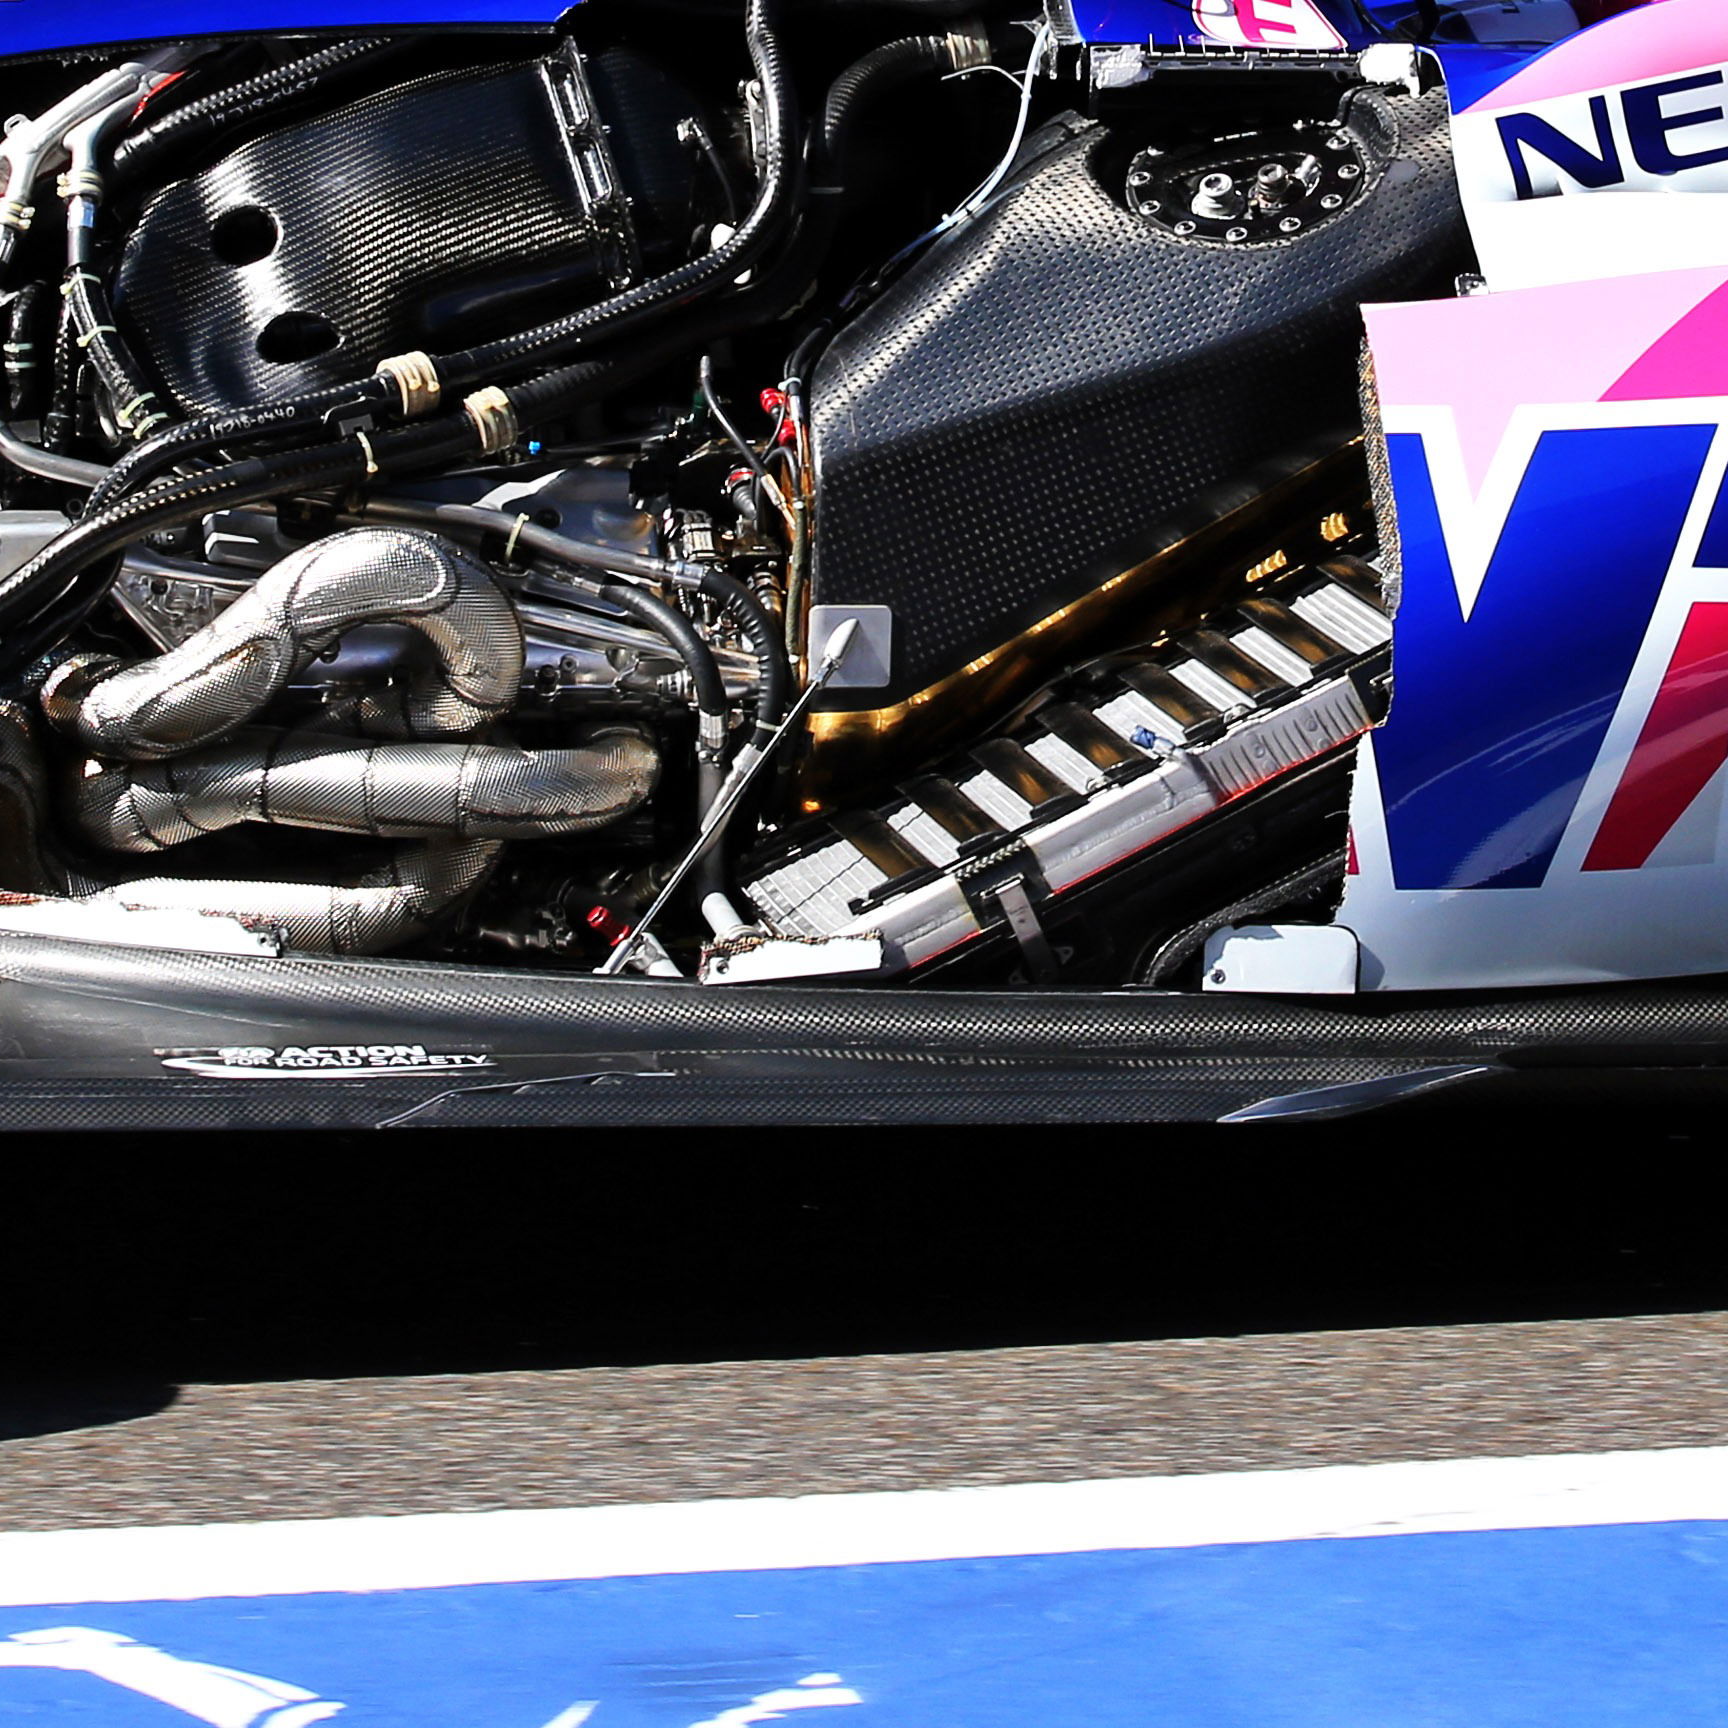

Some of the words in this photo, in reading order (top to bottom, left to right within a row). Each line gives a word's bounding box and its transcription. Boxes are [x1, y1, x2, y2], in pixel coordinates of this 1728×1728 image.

[280, 1045, 426, 1059] ACTION
[224, 1057, 270, 1066] FOR
[275, 1056, 363, 1068] ROAD
[368, 1054, 488, 1066] SAFETY
